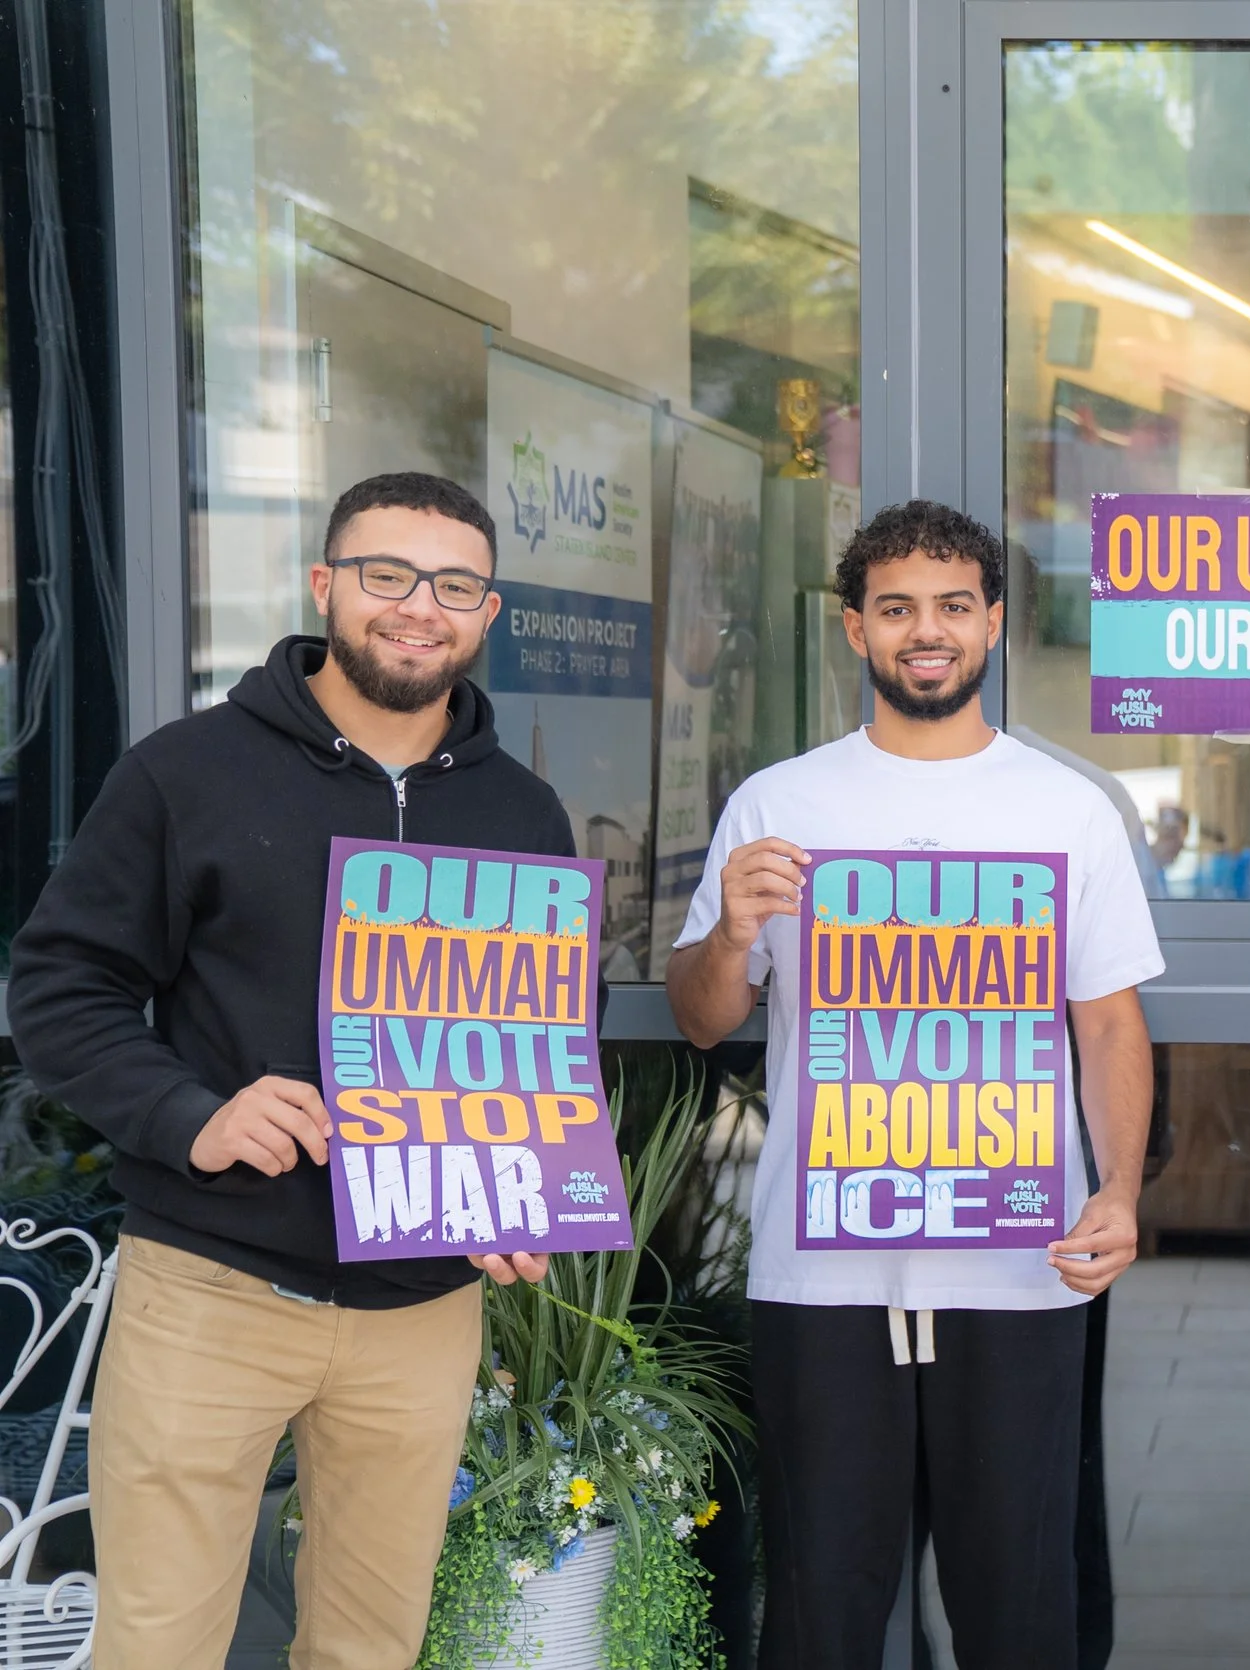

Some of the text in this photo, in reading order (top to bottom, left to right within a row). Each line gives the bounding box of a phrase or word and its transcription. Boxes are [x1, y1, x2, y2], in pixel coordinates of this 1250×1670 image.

[554, 465, 606, 531] MAS
[1108, 514, 1222, 592] OUR
[511, 608, 637, 649] EXPANSION PROJECT
[1112, 701, 1162, 717] MUSLIM
[1119, 714, 1155, 728] VOTE
[340, 850, 591, 940] OUR
[813, 858, 1055, 929] OUR
[339, 931, 582, 1020] UMMAH
[817, 934, 1049, 1005] UMMAH
[332, 1015, 376, 1087] OUR
[386, 1017, 595, 1094] VOTE
[808, 1010, 846, 1081] OUR
[859, 1011, 1055, 1081] VOTE
[336, 1088, 599, 1144] STOP
[808, 1081, 1055, 1169] ABOLISH
[341, 1144, 550, 1243] WAR
[562, 1182, 609, 1195] MUSLIM
[570, 1193, 604, 1204] VOTE
[806, 1169, 990, 1240] ICE
[1003, 1191, 1049, 1204] MUSLIM
[1010, 1202, 1042, 1214] VOTE
